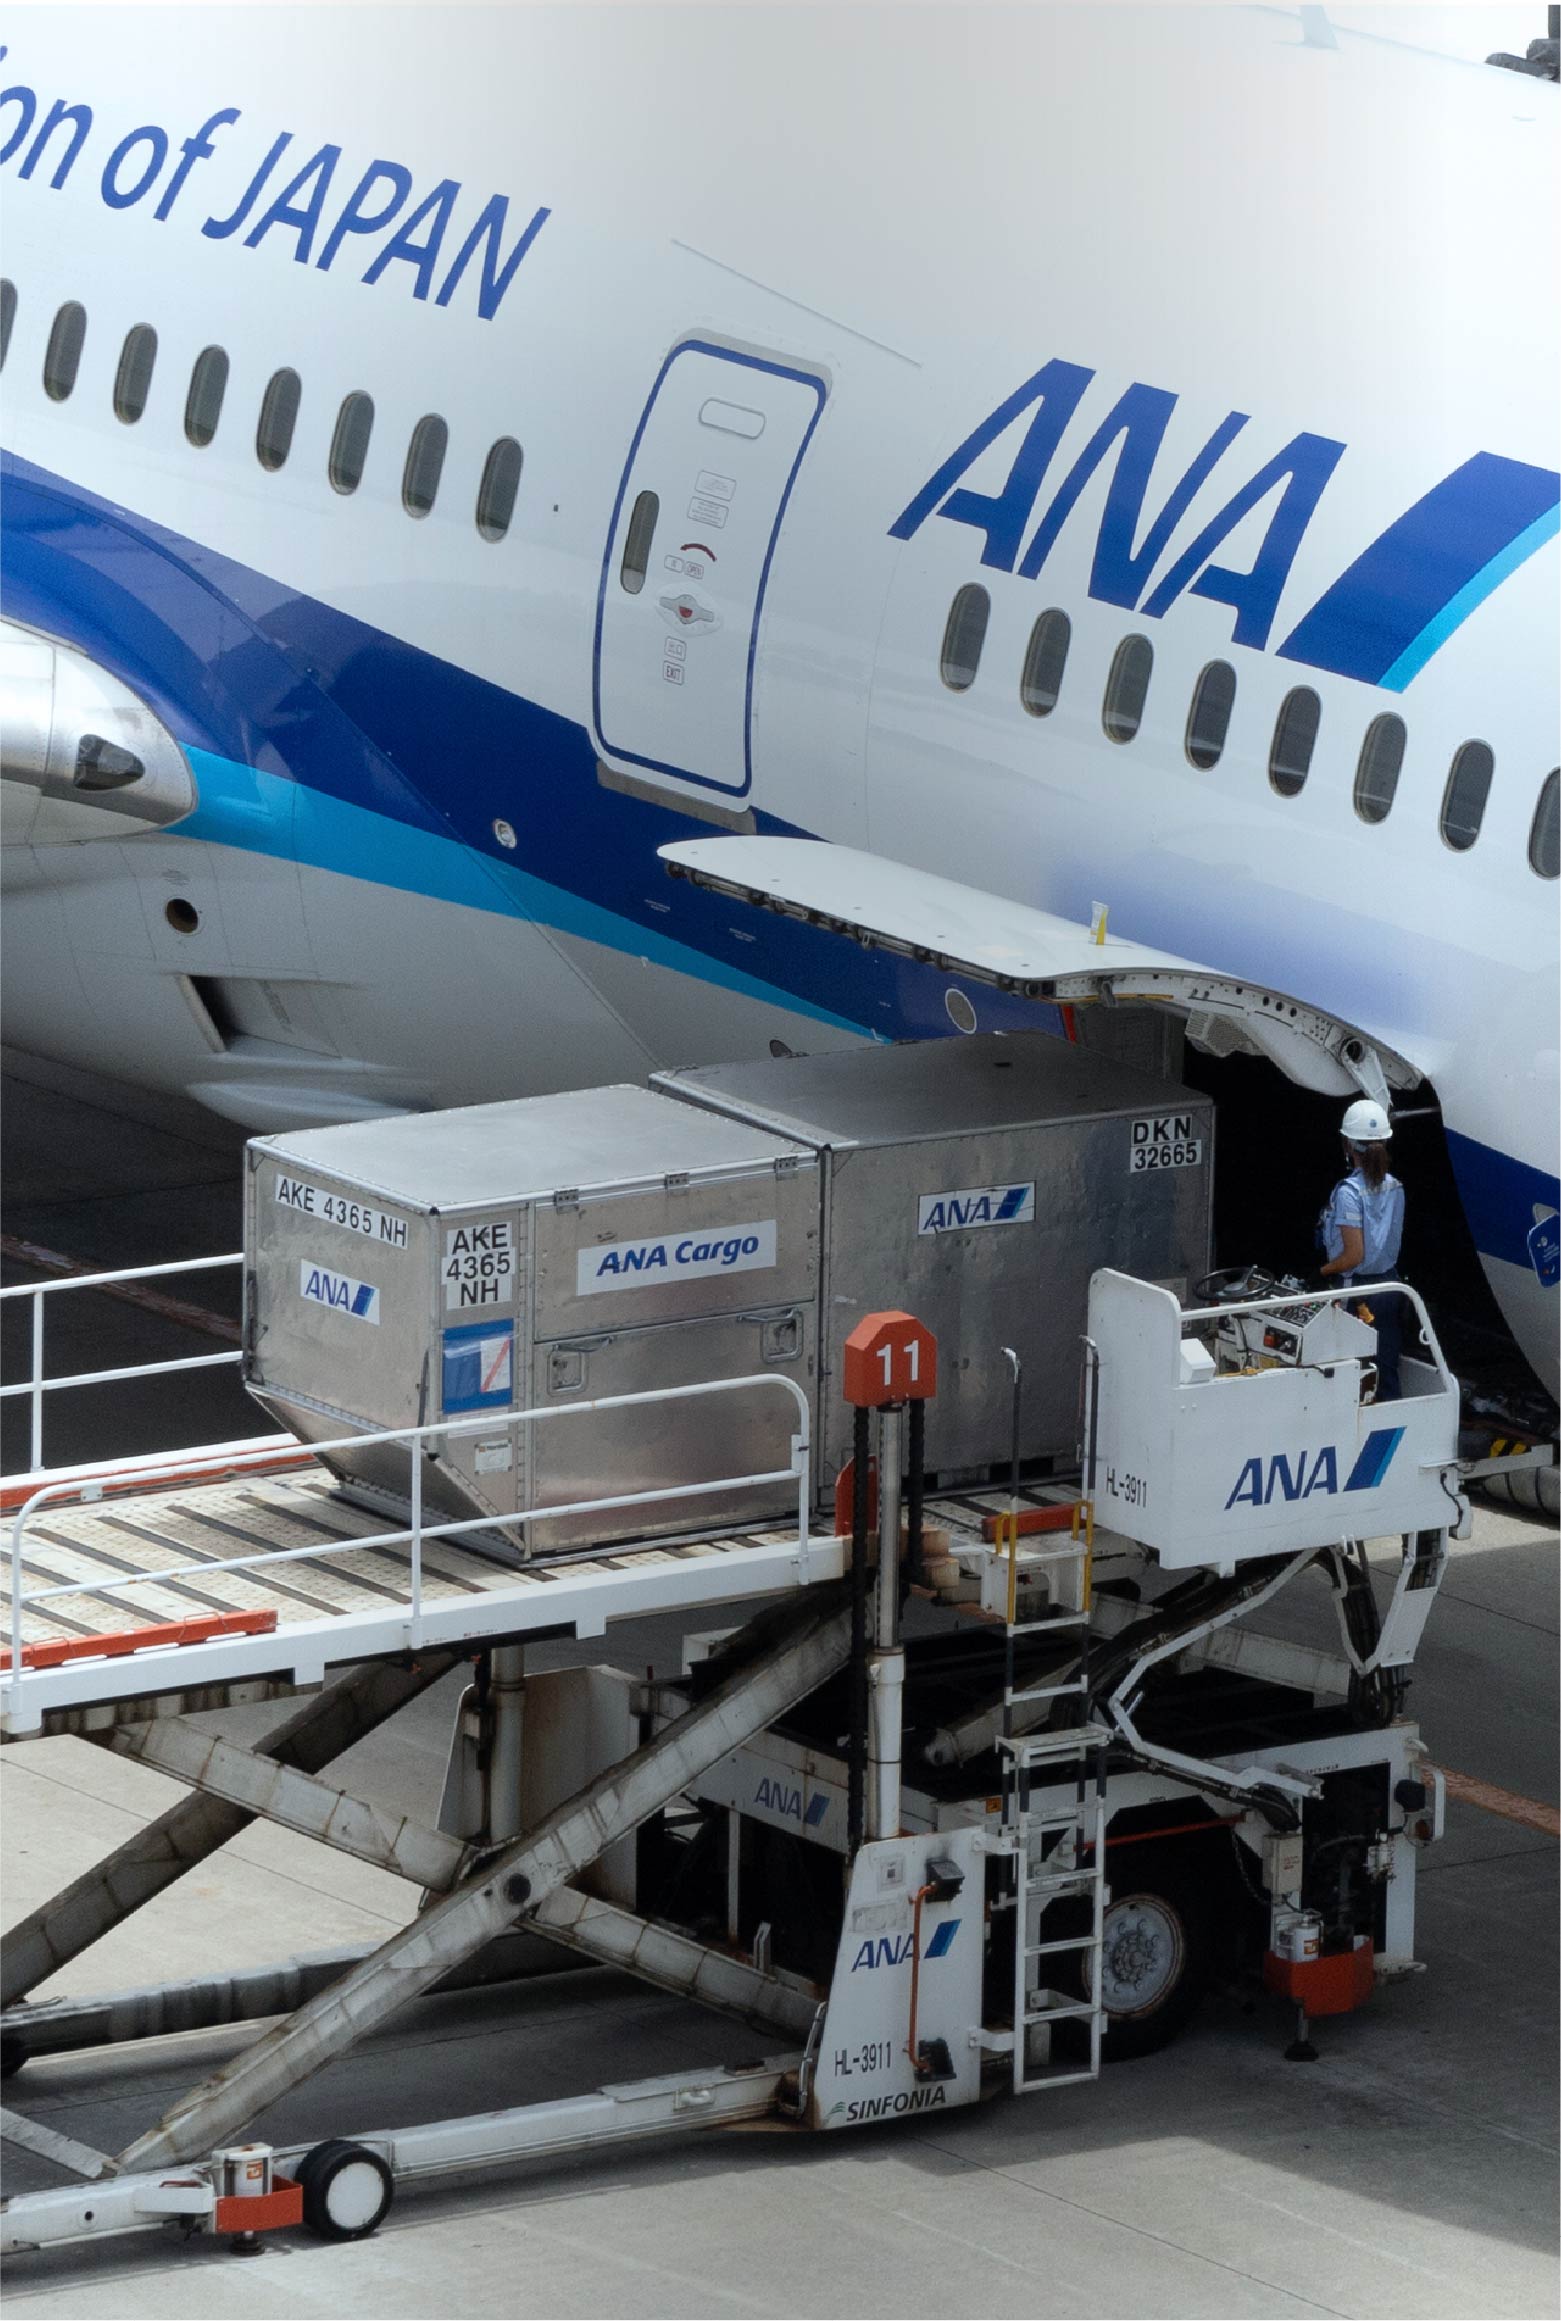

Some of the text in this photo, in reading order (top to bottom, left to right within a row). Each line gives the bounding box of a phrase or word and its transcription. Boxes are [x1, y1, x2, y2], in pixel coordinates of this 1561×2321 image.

[0, 45, 552, 321] on of JAPAN
[887, 358, 1347, 652] ANA
[1133, 1117, 1192, 1144] DKN
[1134, 1142, 1198, 1169] 32665
[278, 1178, 407, 1247] AKE 4365 NH
[923, 1196, 991, 1230] ANA
[452, 1223, 508, 1255] AKE
[596, 1235, 759, 1278] ANA Cargo
[446, 1251, 511, 1281] 4365
[305, 1269, 351, 1312] ANA
[460, 1278, 499, 1307] NH
[876, 1339, 919, 1387] 11
[1105, 1465, 1147, 1508] HL-3911
[1224, 1445, 1338, 1511] ANA
[753, 1776, 802, 1820] ANA
[851, 1933, 915, 1973] ANA
[834, 2040, 892, 2077] HL-3911
[846, 2084, 947, 2122] SINFONIA
